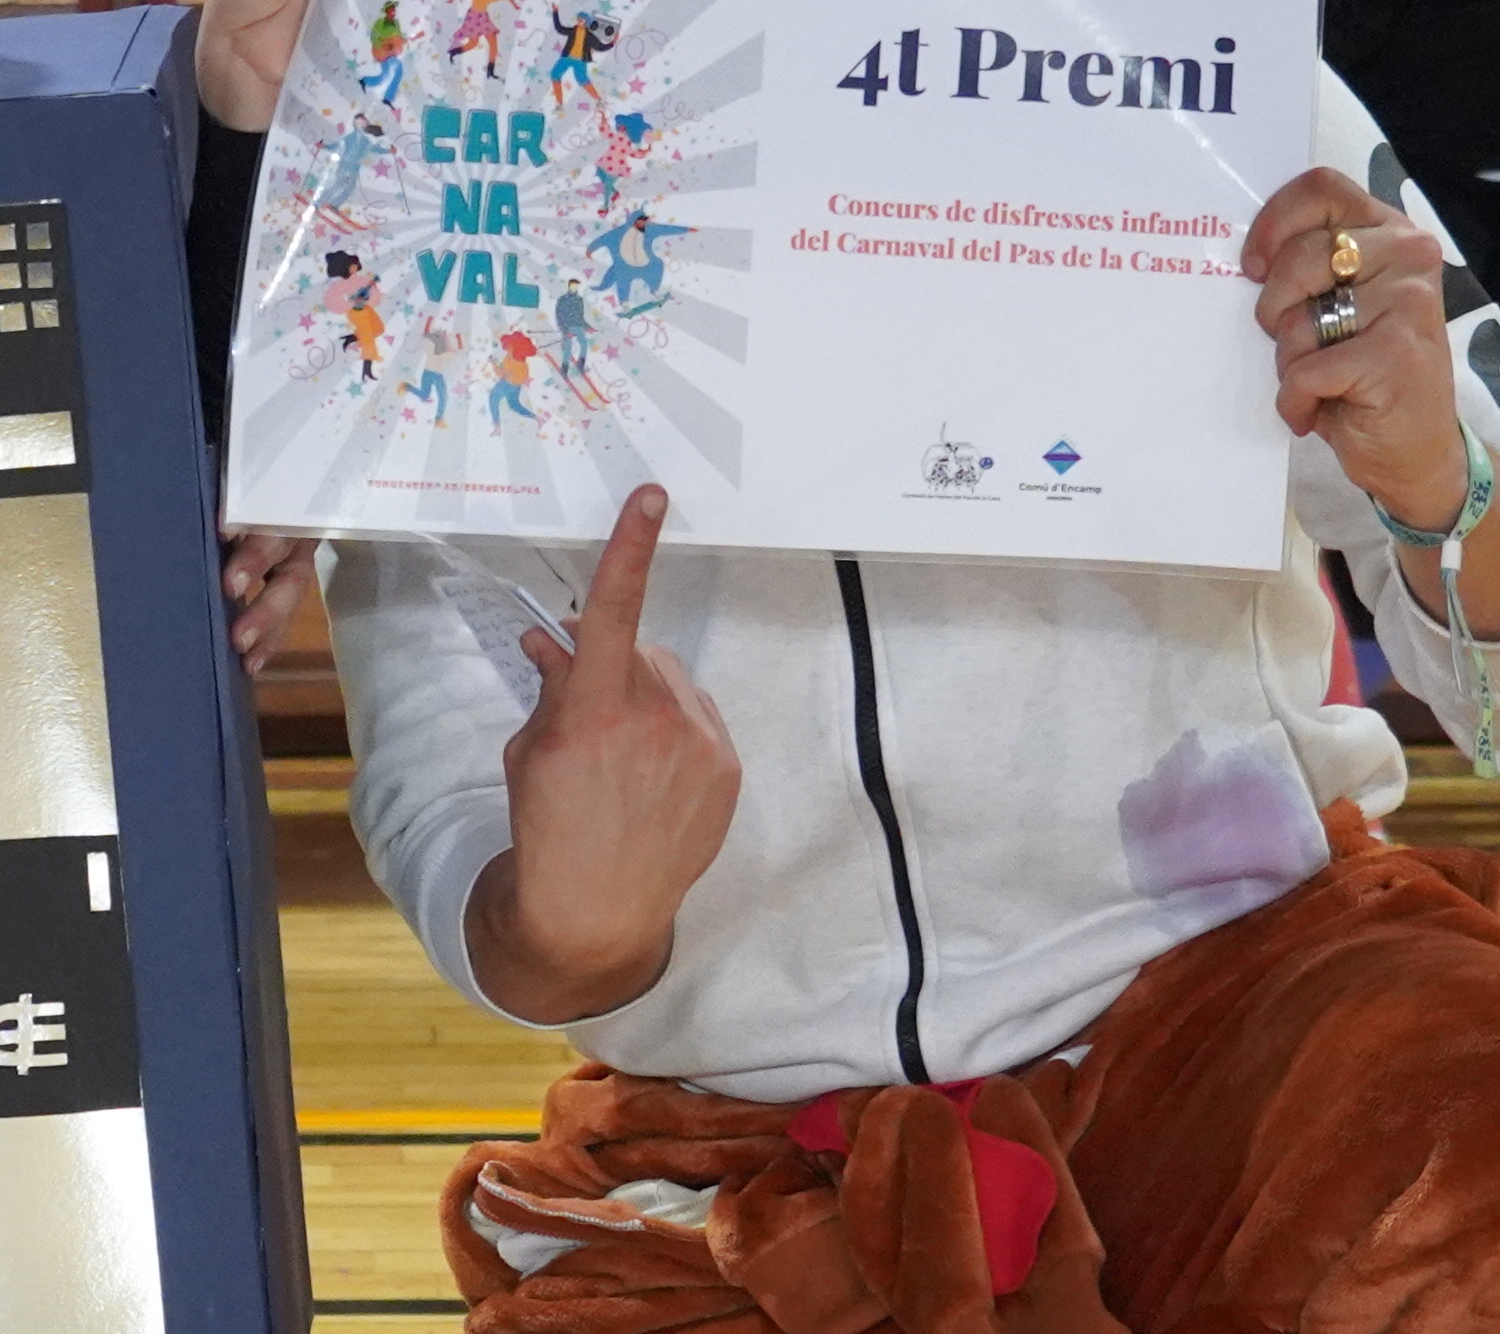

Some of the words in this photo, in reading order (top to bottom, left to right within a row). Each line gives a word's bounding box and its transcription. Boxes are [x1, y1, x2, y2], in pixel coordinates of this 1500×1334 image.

[836, 28, 929, 107] 4t
[950, 27, 1238, 116] Premi
[421, 105, 547, 168] CAR
[440, 178, 521, 236] NA
[828, 193, 939, 222] Concurs
[945, 198, 978, 224] de
[983, 200, 1115, 233] disfresses
[1120, 211, 1233, 241] infantils
[415, 248, 541, 309] VAL
[790, 228, 830, 254] del
[837, 231, 955, 262] Carnaval
[962, 236, 1002, 264] del
[1008, 243, 1056, 269] Pas
[1061, 245, 1094, 271] de
[1099, 248, 1123, 273] la
[1130, 251, 1193, 276] Casa
